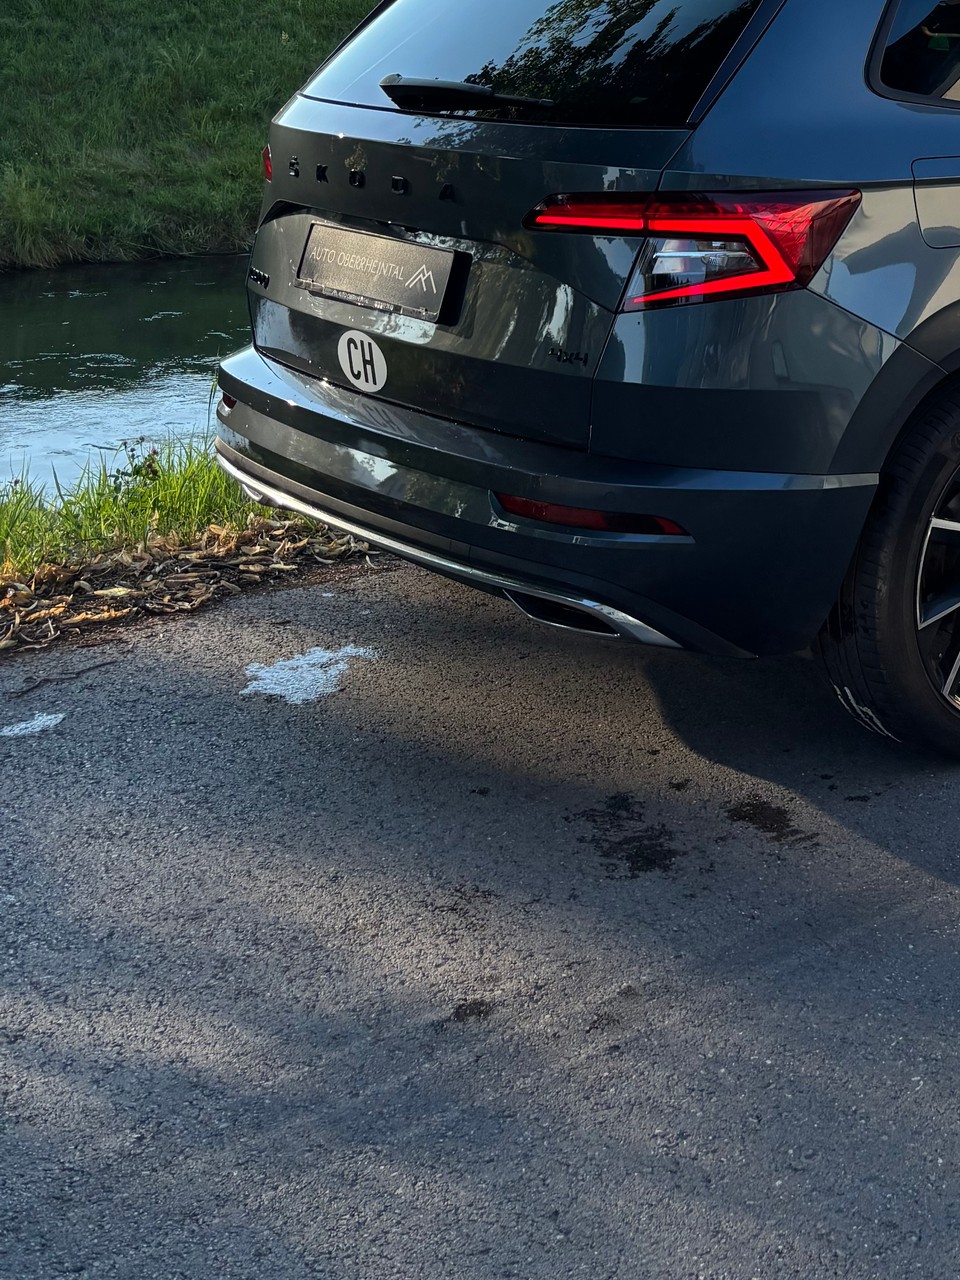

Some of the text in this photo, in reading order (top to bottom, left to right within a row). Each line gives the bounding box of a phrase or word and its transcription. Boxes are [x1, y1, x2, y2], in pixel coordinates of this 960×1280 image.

[309, 246, 404, 280] AUTO OBERRHEINTAL
[347, 337, 377, 386] CH
